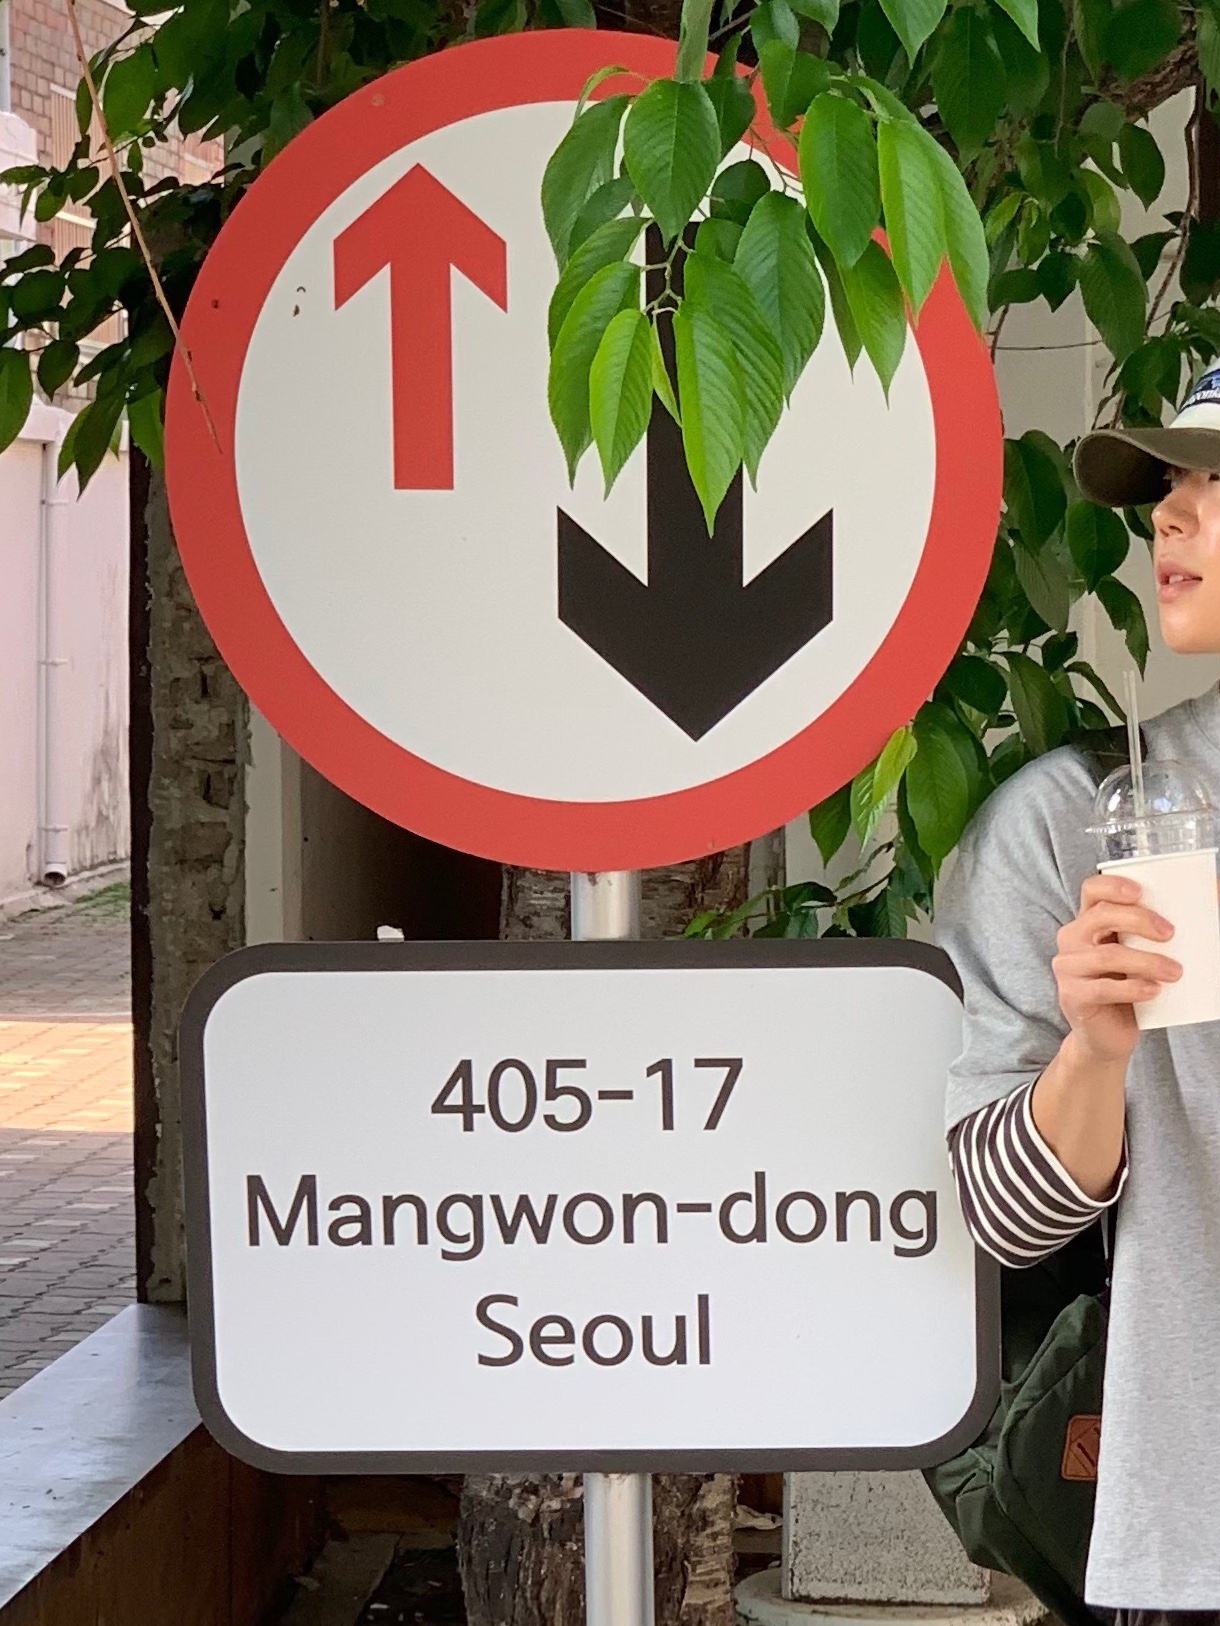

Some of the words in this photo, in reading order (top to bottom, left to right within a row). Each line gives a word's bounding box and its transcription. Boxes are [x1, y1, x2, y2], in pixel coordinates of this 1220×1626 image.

[430, 1057, 743, 1133] 405-17
[246, 1171, 938, 1262] Mangwon-dong
[475, 1293, 711, 1367] Seoul
